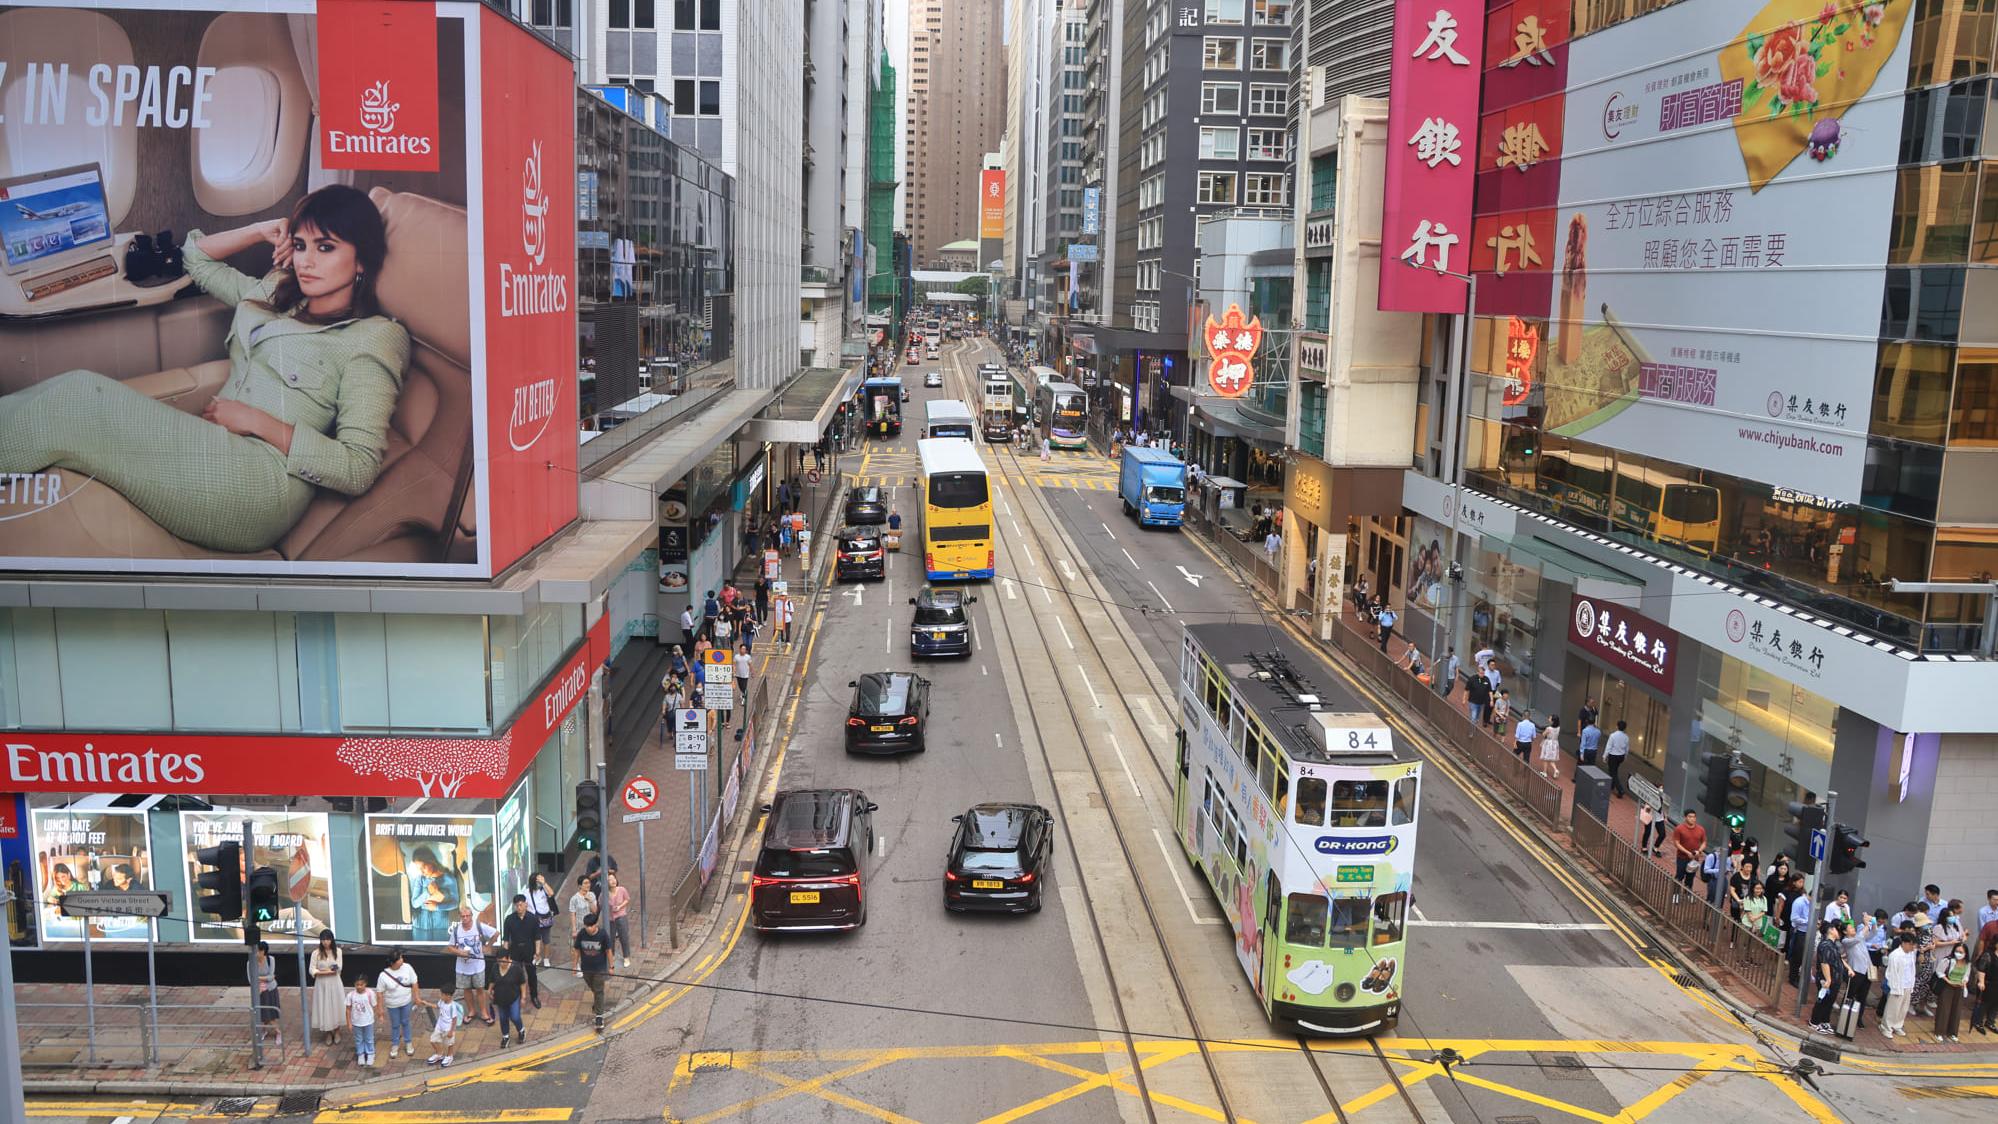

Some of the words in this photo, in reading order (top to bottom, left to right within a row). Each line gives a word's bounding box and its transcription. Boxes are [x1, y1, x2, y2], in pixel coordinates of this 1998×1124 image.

[1179, 7, 1198, 26] 記
[24, 62, 69, 125] IN
[86, 63, 216, 129] SPACE
[1660, 81, 1743, 131] 財富管理
[329, 131, 431, 154] Emirates
[1606, 189, 1734, 231] 全方位綜合服務
[1643, 233, 1787, 269] 照顧您全面需要
[500, 256, 567, 317] Emirates
[1638, 365, 1716, 406] 工商服務
[514, 386, 528, 428] FLY
[529, 378, 555, 422] BETTER
[1787, 394, 1847, 420] 集友銀行
[1739, 428, 1843, 456] www.chiyubank.com
[1598, 610, 1667, 665] 集友銀行
[1750, 620, 1825, 669] 集友銀行
[545, 661, 586, 730] Emirates
[1349, 731, 1378, 749] 84
[6, 743, 205, 783] Emirates
[1300, 766, 1314, 777] 84
[1406, 767, 1417, 777] 84
[44, 819, 69, 831] LUNCH
[71, 820, 90, 832] DATE
[88, 832, 106, 844] FEET
[376, 824, 395, 836] DRIFT
[397, 824, 413, 836] INTO
[415, 825, 446, 837] ANOTHER
[448, 825, 473, 837] WORLD
[254, 835, 269, 846] YOU
[273, 835, 302, 847] BOARD
[77, 897, 99, 905] Queen
[101, 897, 127, 905] Victoria
[128, 897, 149, 905] Street
[1387, 1006, 1397, 1016] 84
